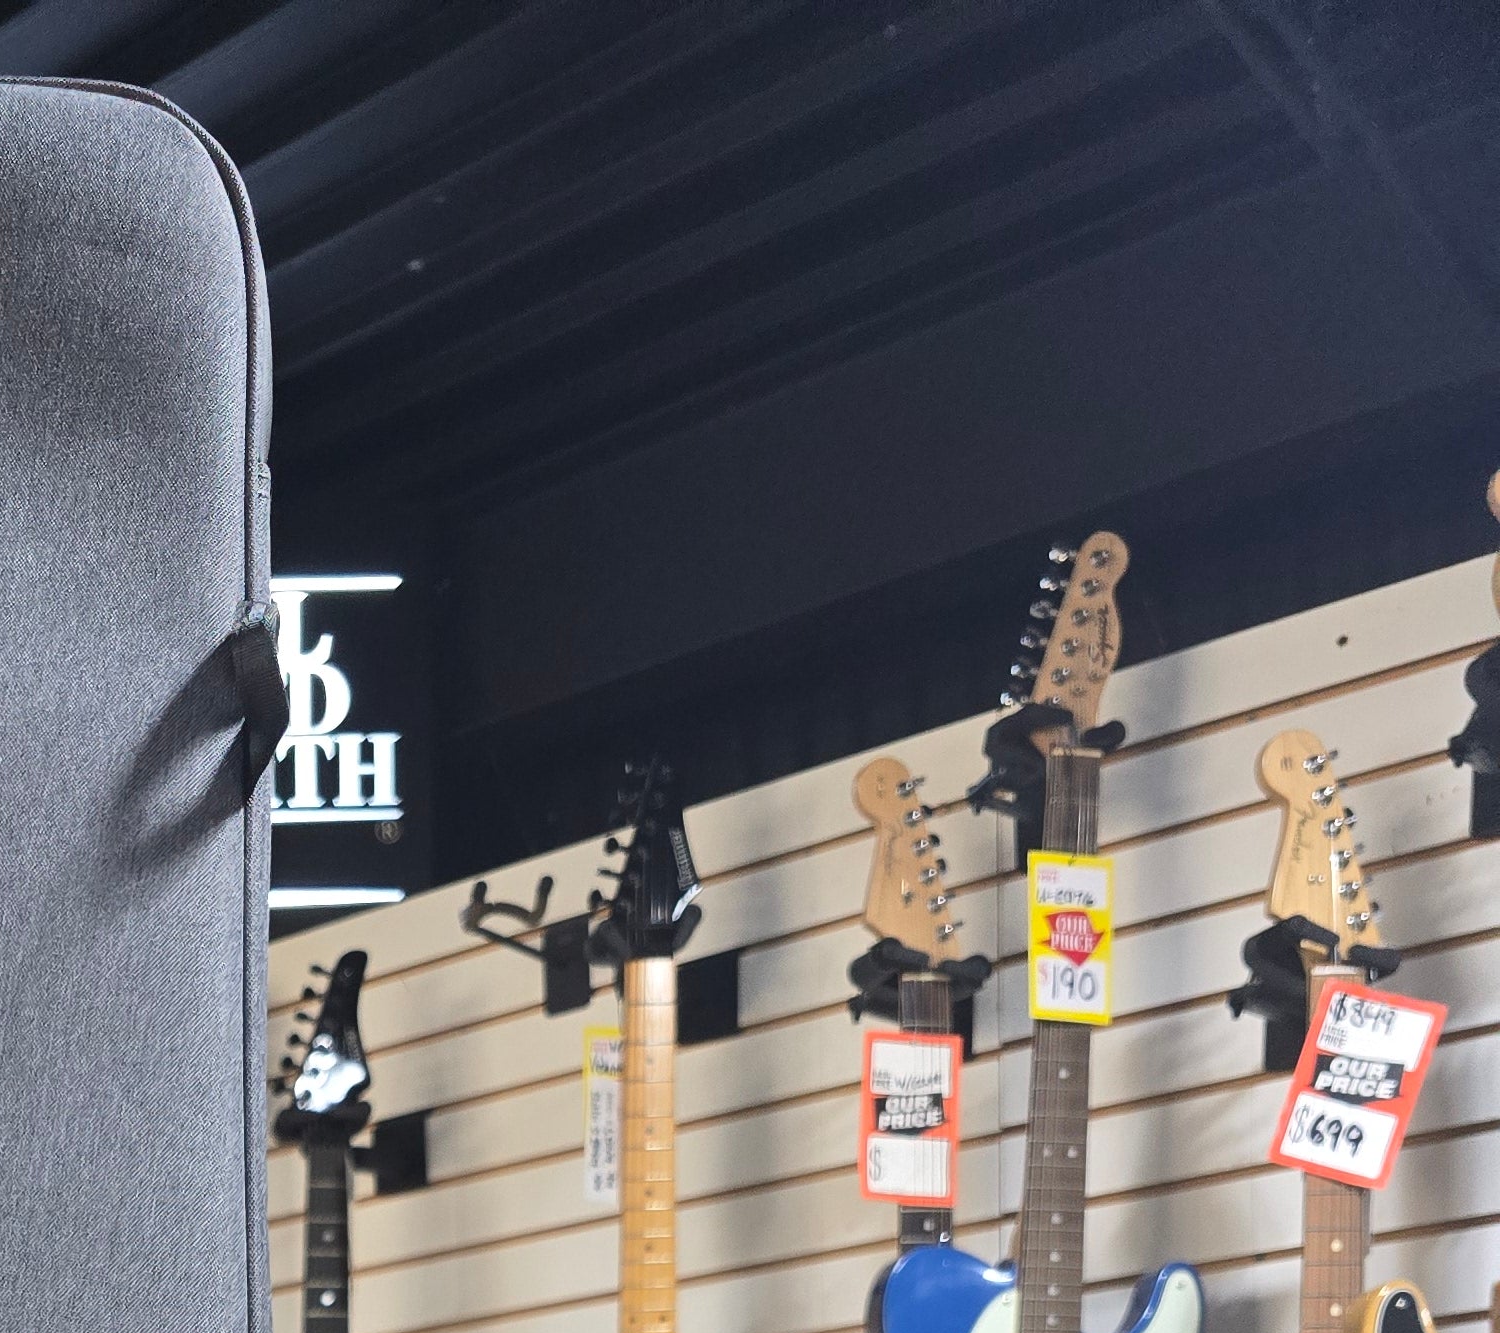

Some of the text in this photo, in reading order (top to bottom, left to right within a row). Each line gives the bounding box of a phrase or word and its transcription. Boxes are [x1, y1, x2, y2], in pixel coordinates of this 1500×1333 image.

[1055, 913, 1089, 935] OUR
[1328, 1055, 1391, 1081] OUR
[1313, 1070, 1400, 1100] PRICE
[885, 1094, 934, 1115] OUR
[878, 1108, 944, 1132] PRICE
